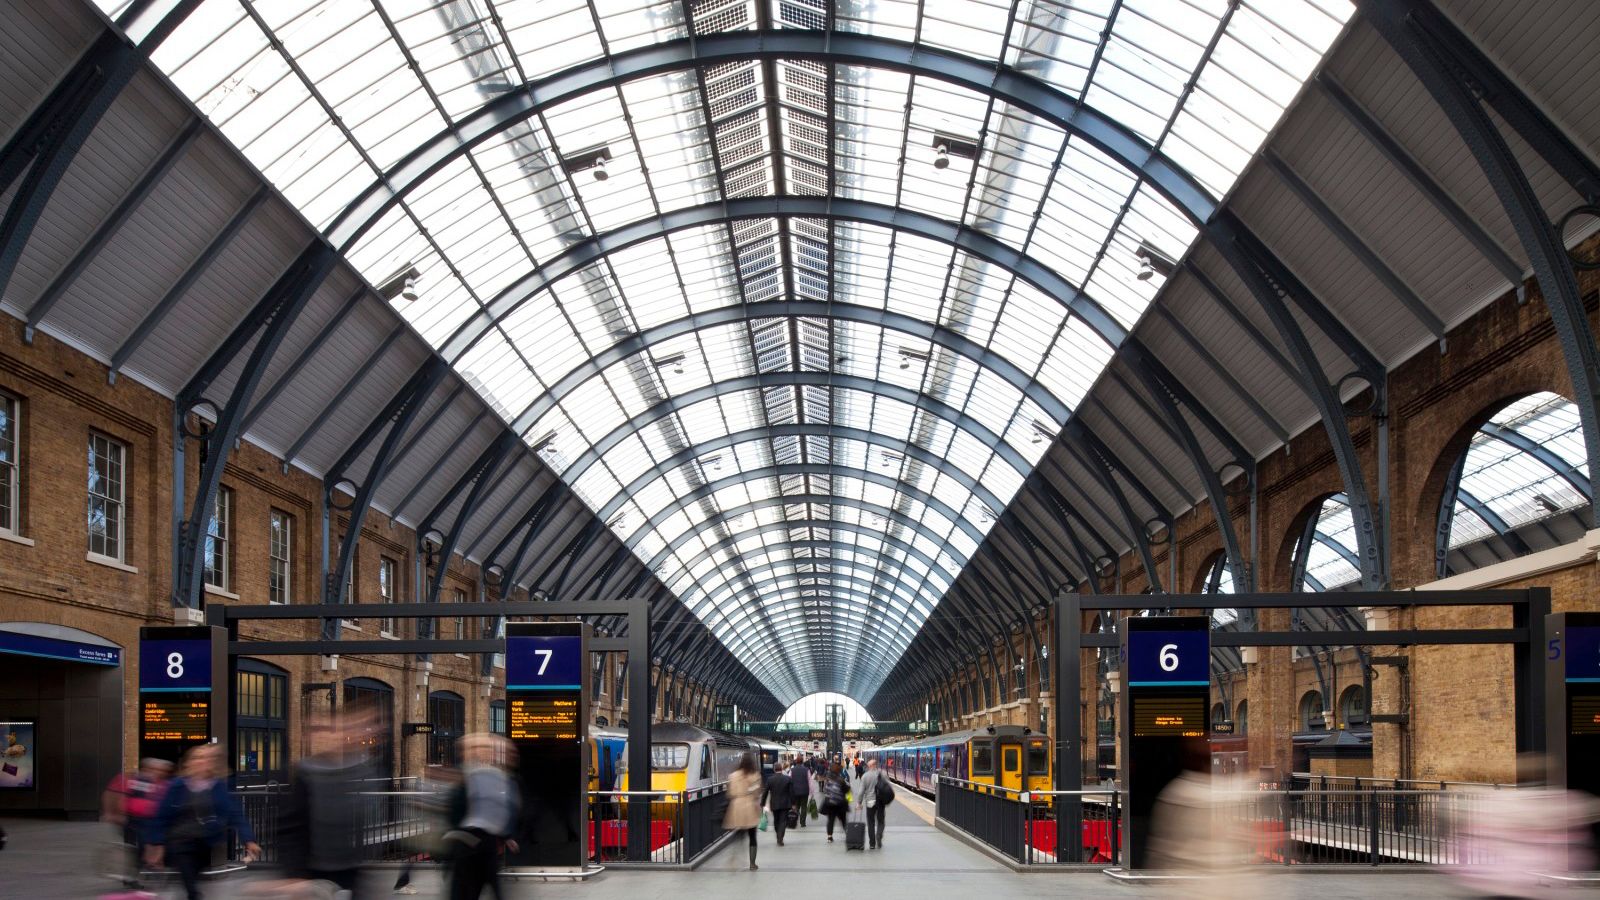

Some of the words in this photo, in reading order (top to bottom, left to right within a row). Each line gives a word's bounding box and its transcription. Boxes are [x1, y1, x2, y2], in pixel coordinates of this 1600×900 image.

[534, 649, 553, 676] 7
[1160, 643, 1179, 672] 6
[1548, 639, 1560, 660] 5
[166, 652, 184, 679] 8
